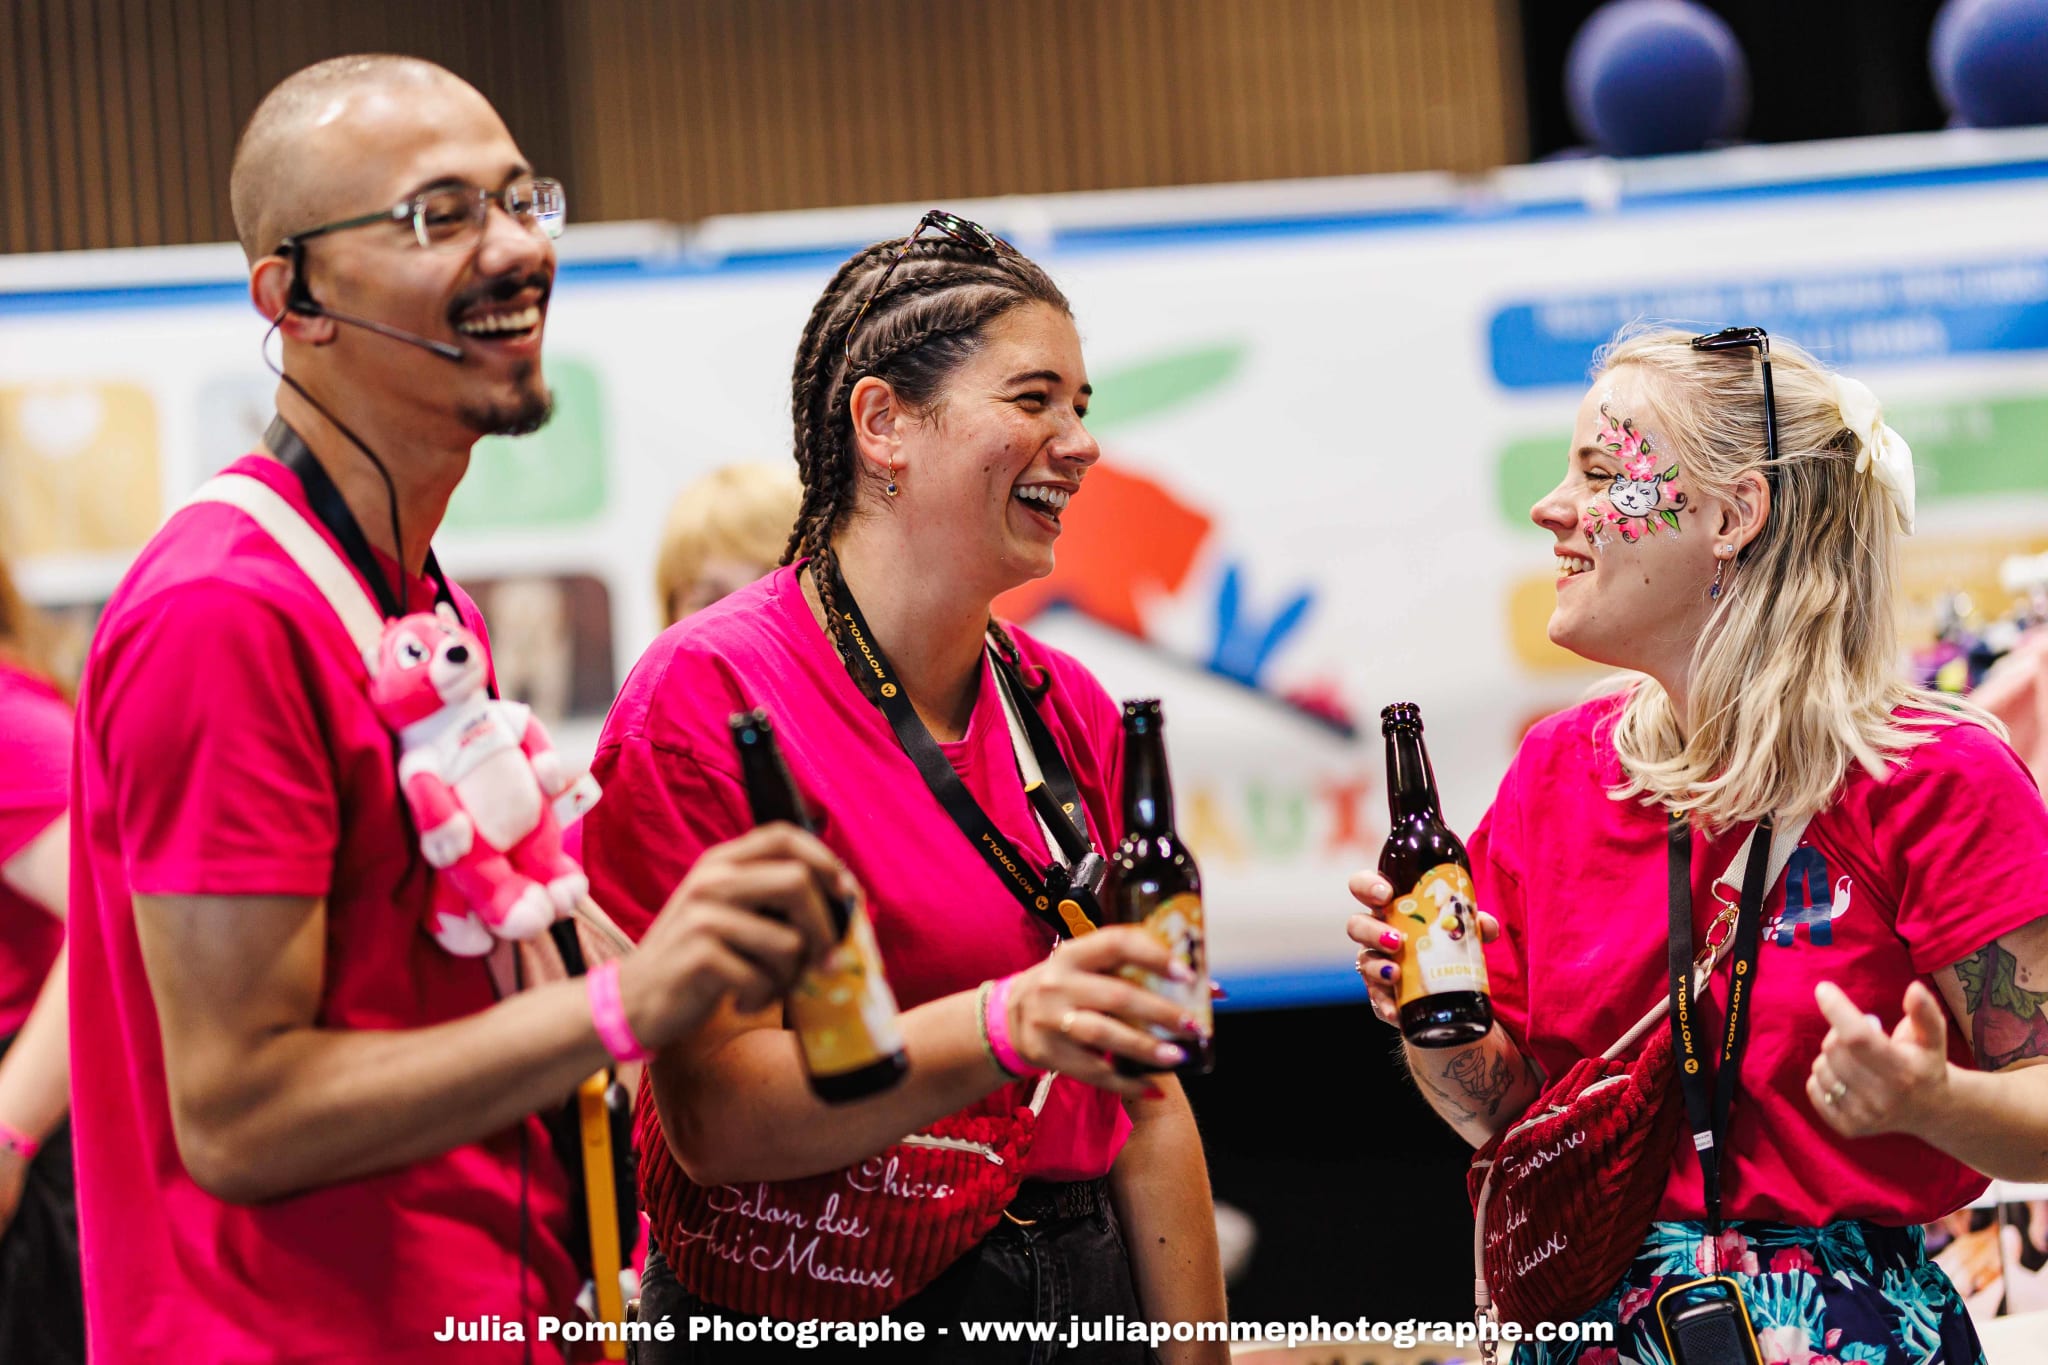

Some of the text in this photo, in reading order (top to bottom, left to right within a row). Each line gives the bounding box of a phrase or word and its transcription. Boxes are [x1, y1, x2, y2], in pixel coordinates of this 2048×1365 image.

[843, 612, 887, 679] MOTOROLA
[982, 832, 1037, 895] MOTOROLA
[1677, 974, 1695, 1054] MOTOROLA
[1724, 979, 1743, 1061] MOTOROLA
[707, 1183, 870, 1238] Salon des
